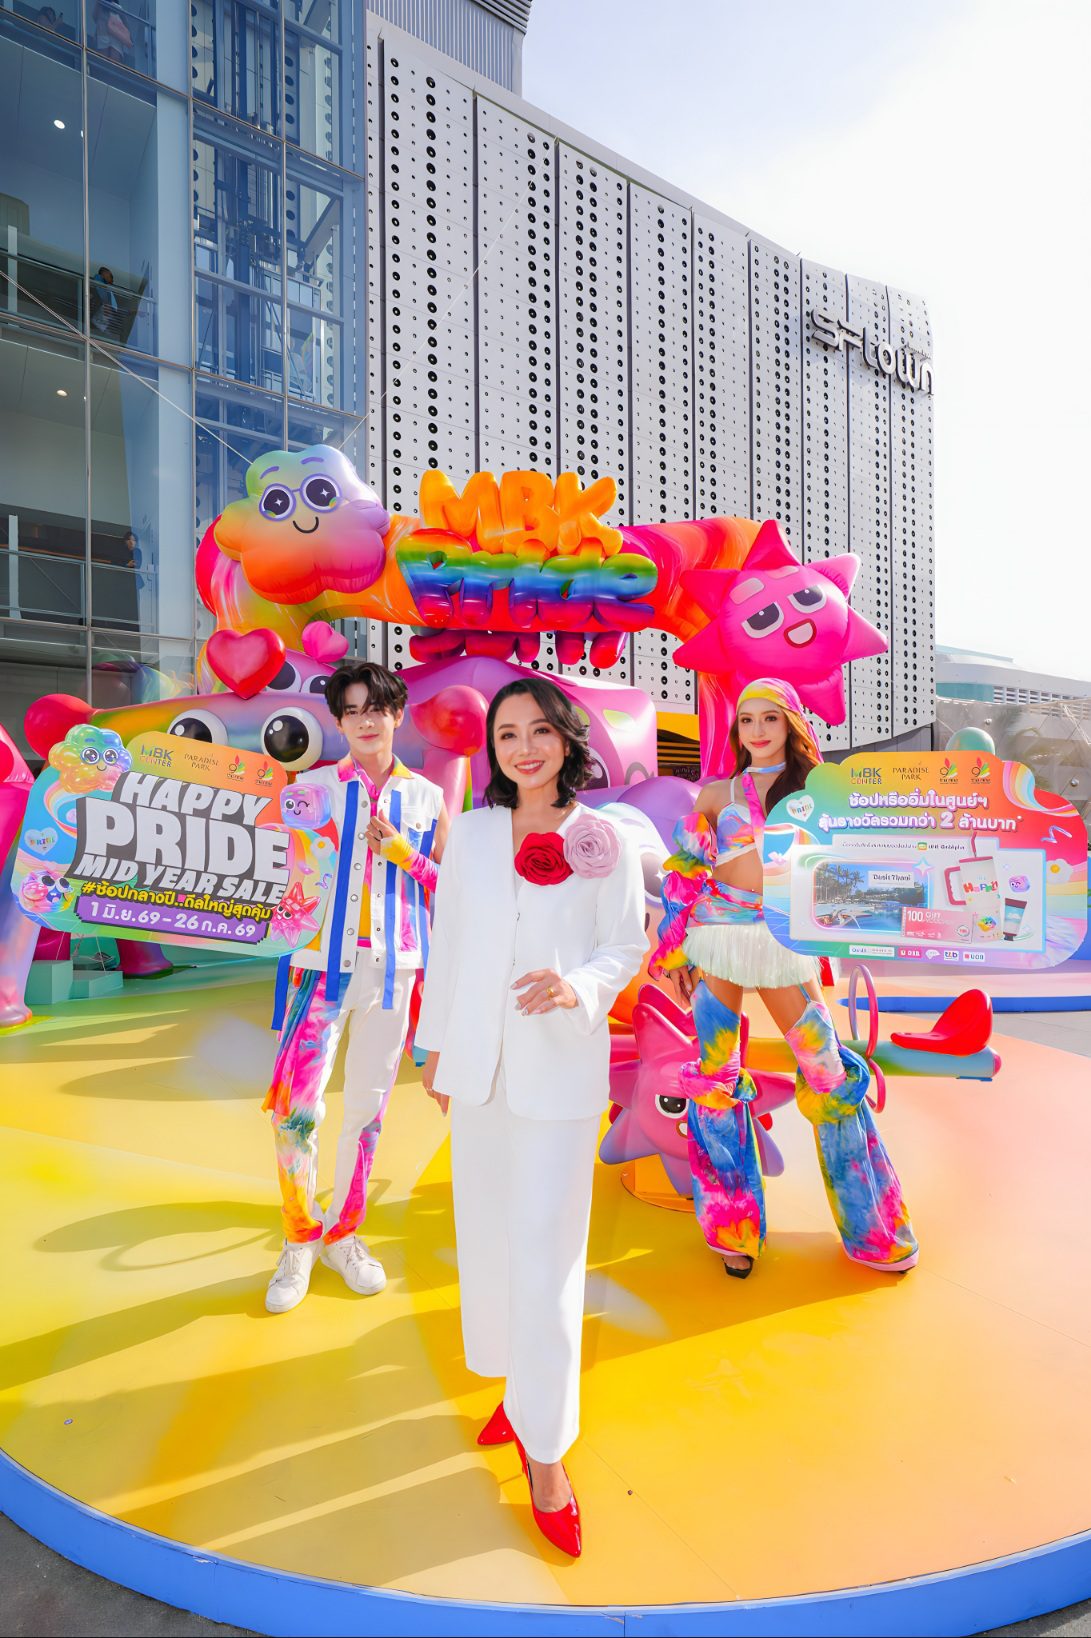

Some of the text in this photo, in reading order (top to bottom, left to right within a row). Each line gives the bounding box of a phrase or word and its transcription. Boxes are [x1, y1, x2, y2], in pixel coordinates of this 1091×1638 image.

[418, 469, 623, 558] MBK
[119, 771, 273, 825] HAPPY
[851, 767, 882, 778] MBK
[85, 796, 290, 885] PRIDE
[940, 811, 954, 829] 2
[73, 853, 288, 905] MID YEAR SALE
[90, 901, 98, 917] 1
[174, 914, 199, 930] 26
[235, 923, 256, 938] 69
